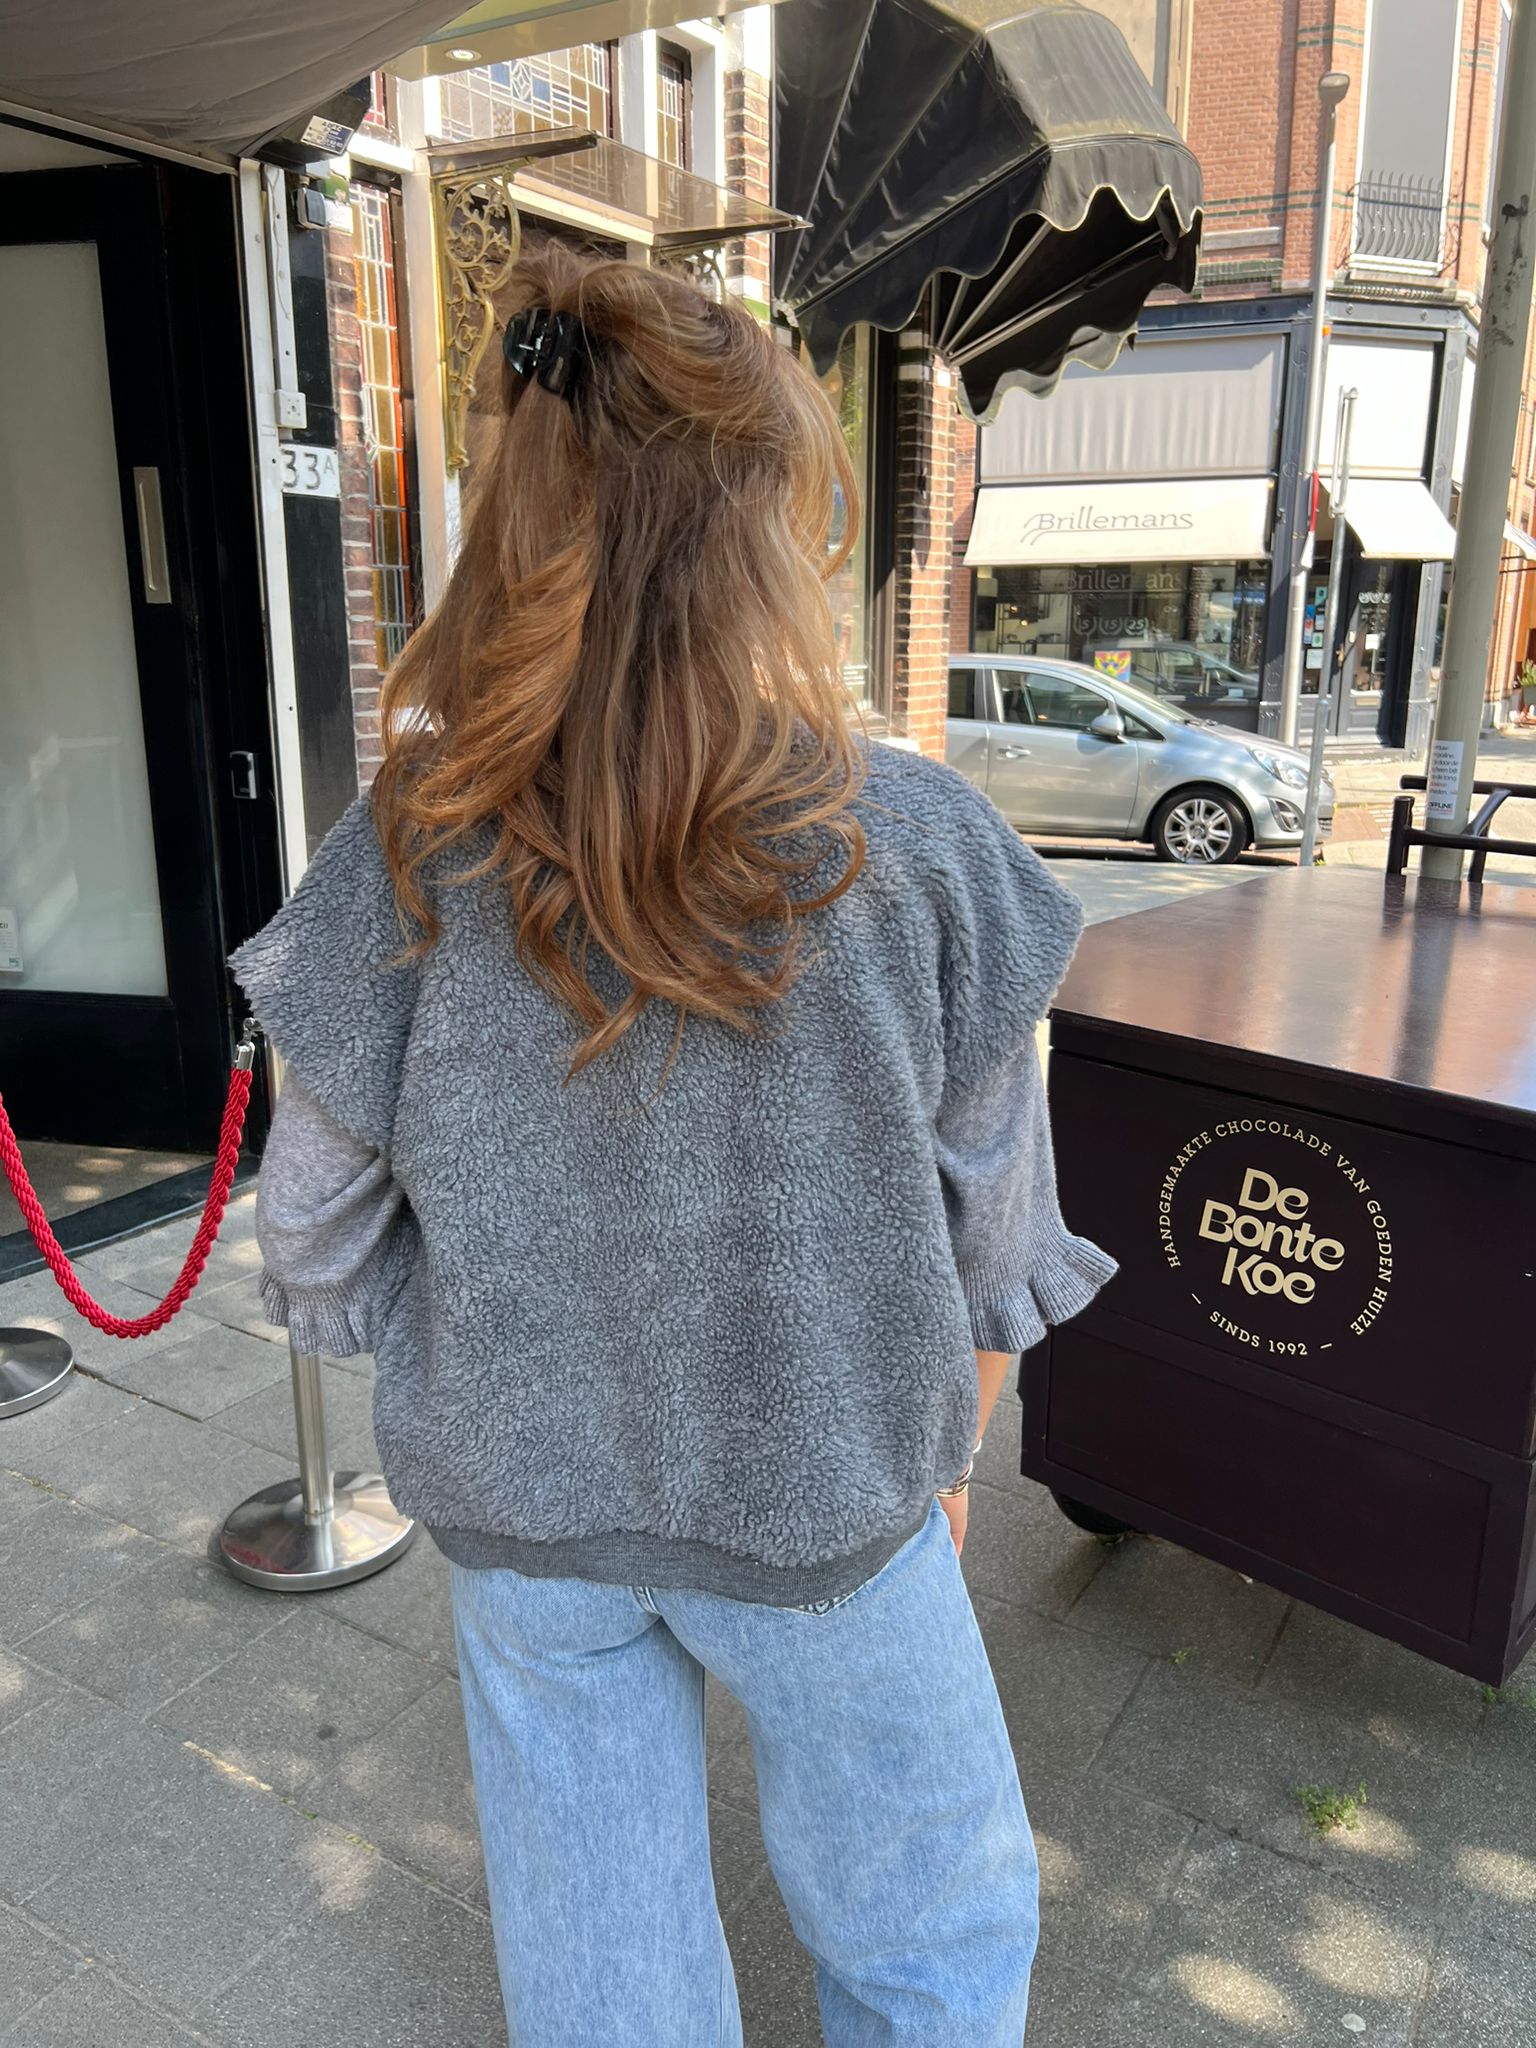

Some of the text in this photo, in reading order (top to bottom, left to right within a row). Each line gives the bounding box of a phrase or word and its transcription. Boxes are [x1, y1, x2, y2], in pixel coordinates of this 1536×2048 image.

[1021, 505, 1194, 542] Brillemans
[1238, 1167, 1309, 1221] De
[1158, 1119, 1392, 1336] HANDGEMAAKTE CHOCOLADE VAN GOEDEN HUIZE
[1198, 1199, 1345, 1272] Bonte
[1221, 1246, 1316, 1305] Koe
[1209, 1311, 1308, 1355] SINDS 1992
